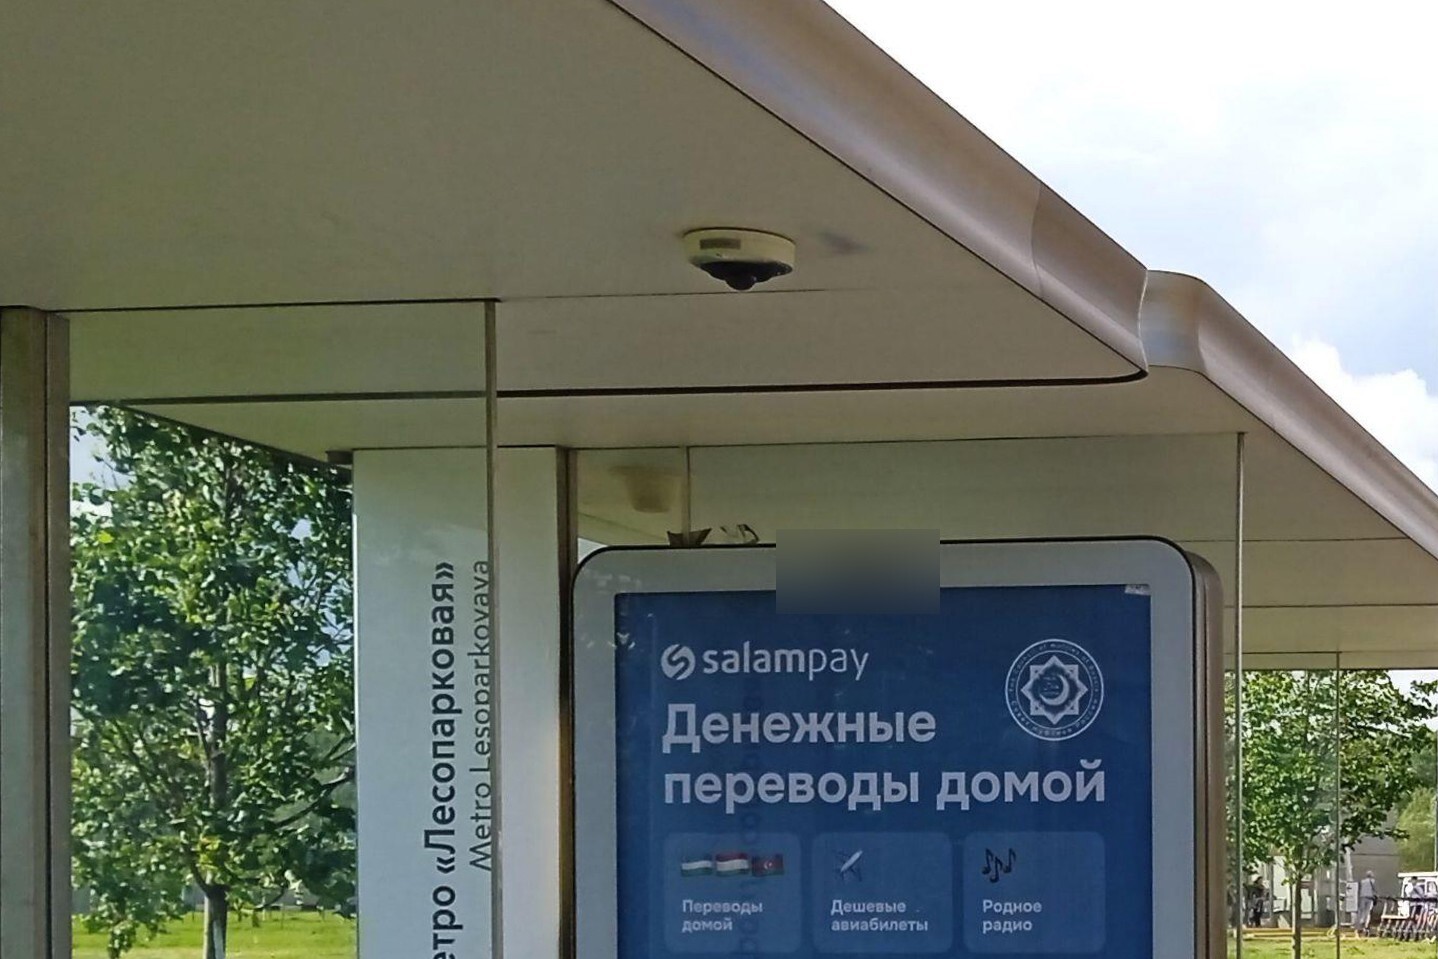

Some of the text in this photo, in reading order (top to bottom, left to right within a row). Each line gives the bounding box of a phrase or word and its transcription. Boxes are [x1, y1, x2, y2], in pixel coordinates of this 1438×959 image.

[703, 641, 869, 680] salampay
[423, 560, 463, 874] «Лесопарковая»
[662, 703, 936, 753] Денежные
[664, 759, 1106, 814] переводы домой
[468, 781, 492, 872] Metro
[682, 899, 763, 915] Переводы
[831, 899, 907, 915] Дешевые
[982, 899, 1042, 915] Родное
[682, 917, 733, 933] домой
[831, 917, 929, 932] авиабилеты
[982, 919, 1033, 934] радио
